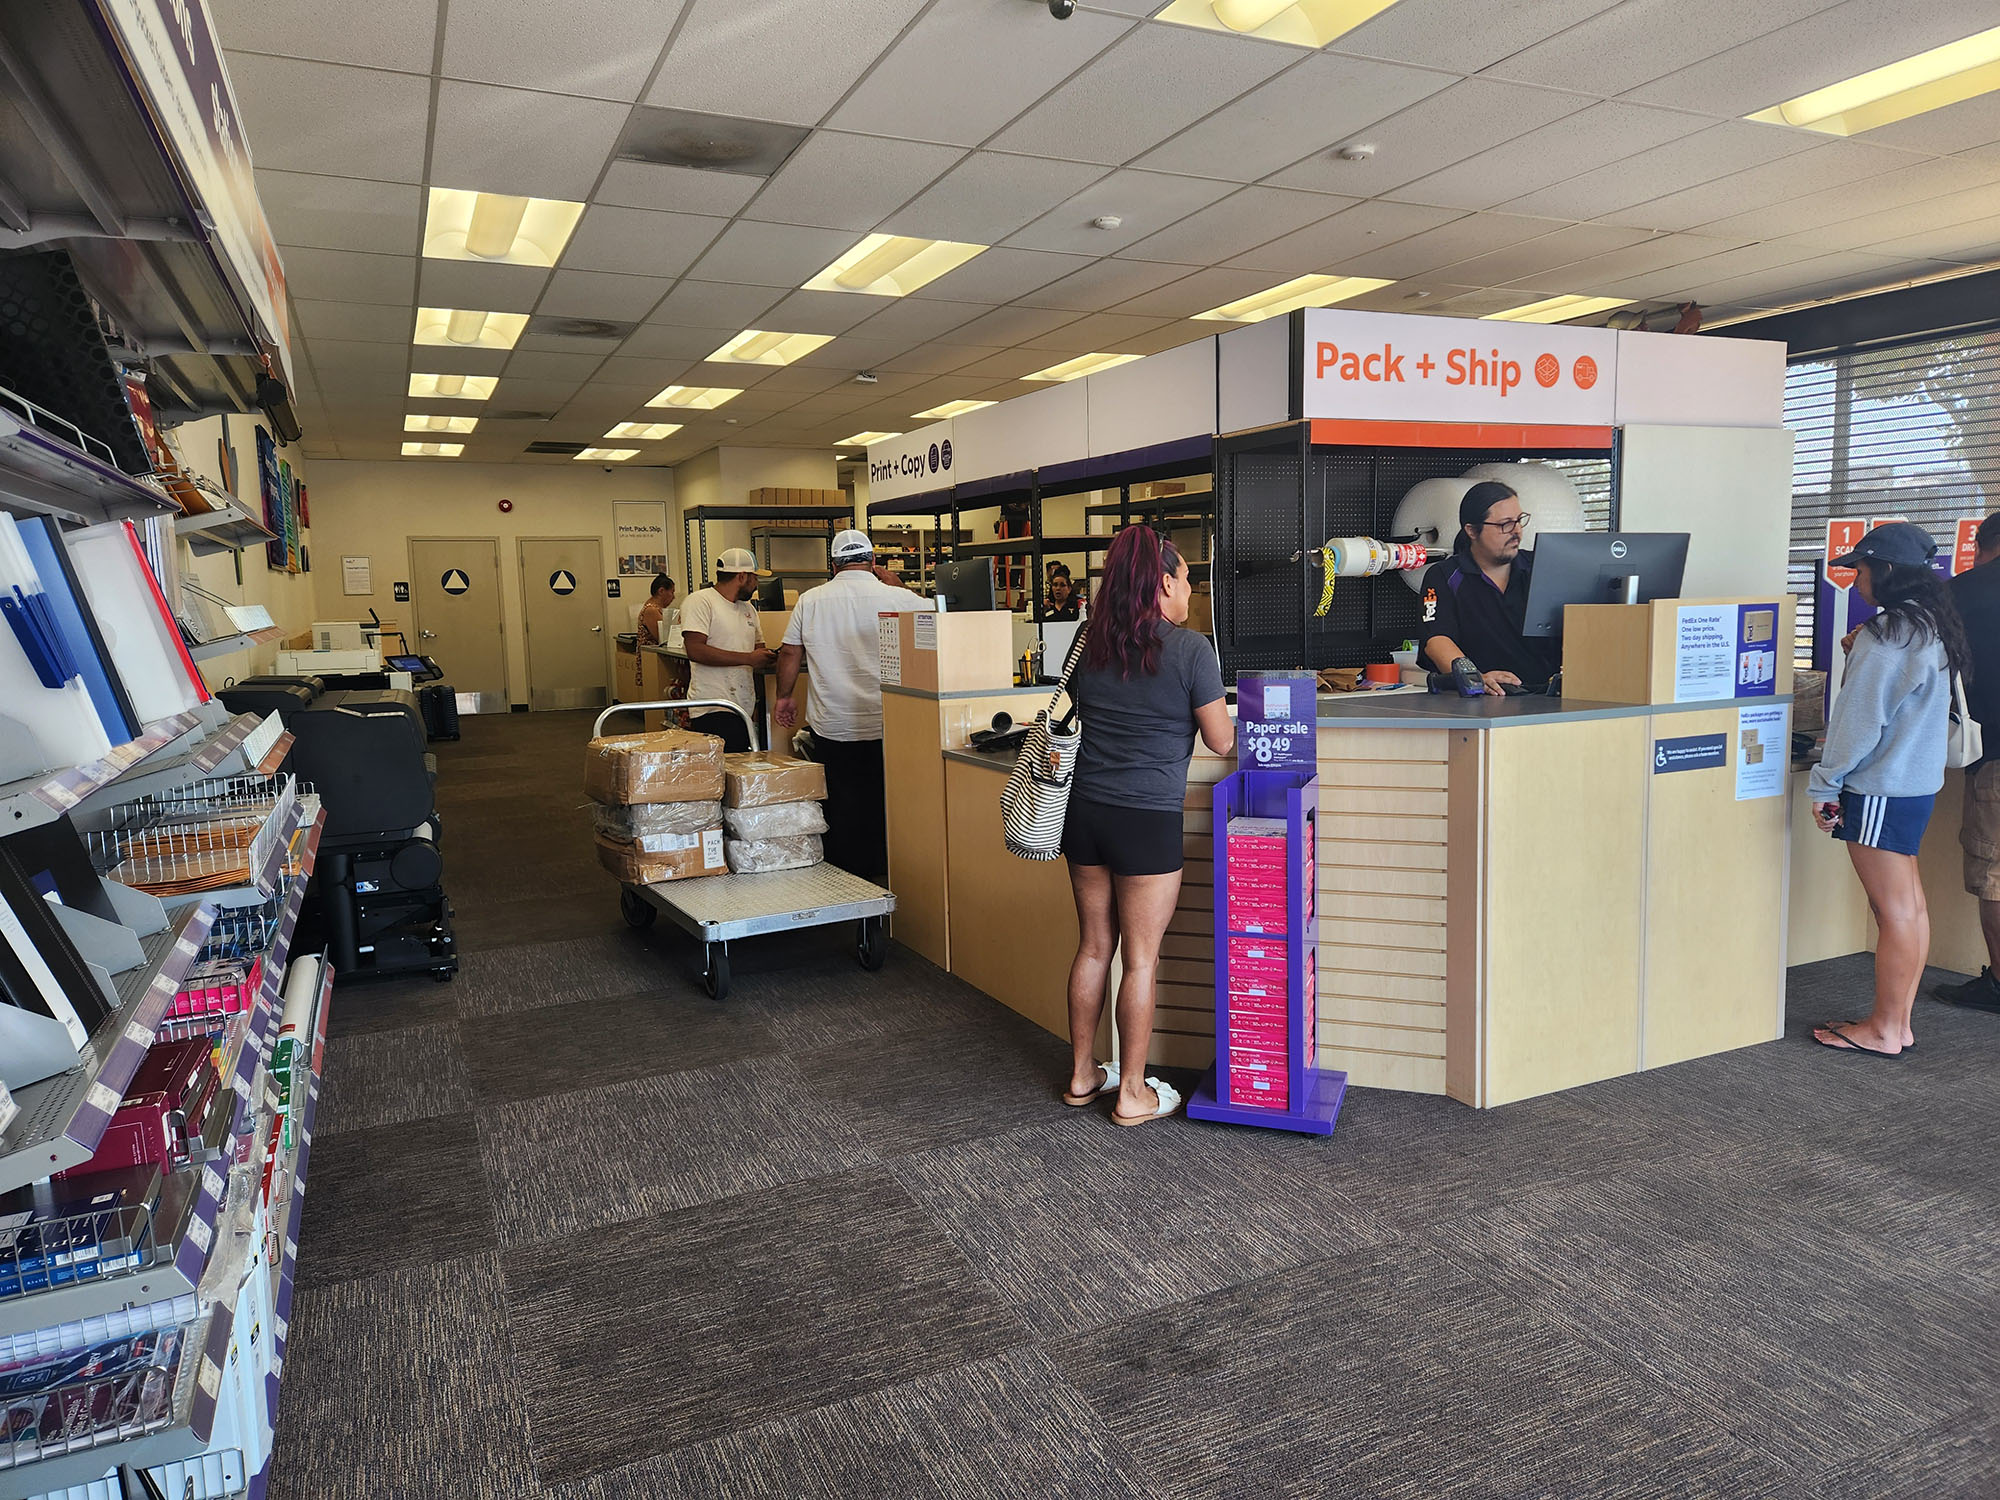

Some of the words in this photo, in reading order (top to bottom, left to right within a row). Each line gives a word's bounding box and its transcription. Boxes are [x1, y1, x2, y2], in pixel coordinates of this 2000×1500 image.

[1316, 342, 1405, 382] Pack
[1416, 354, 1435, 378] +
[1446, 348, 1521, 396] Ship
[871, 460, 892, 483] Print
[894, 460, 899, 474] +
[901, 454, 925, 478] Copy
[1843, 526, 1850, 544] 1
[1968, 525, 1977, 541] 3
[1962, 543, 1976, 551] DRO
[1422, 588, 1437, 622] FedEx
[1246, 721, 1281, 736] Paper
[1283, 721, 1308, 734] sale
[84, 1352, 101, 1377] AVERY
